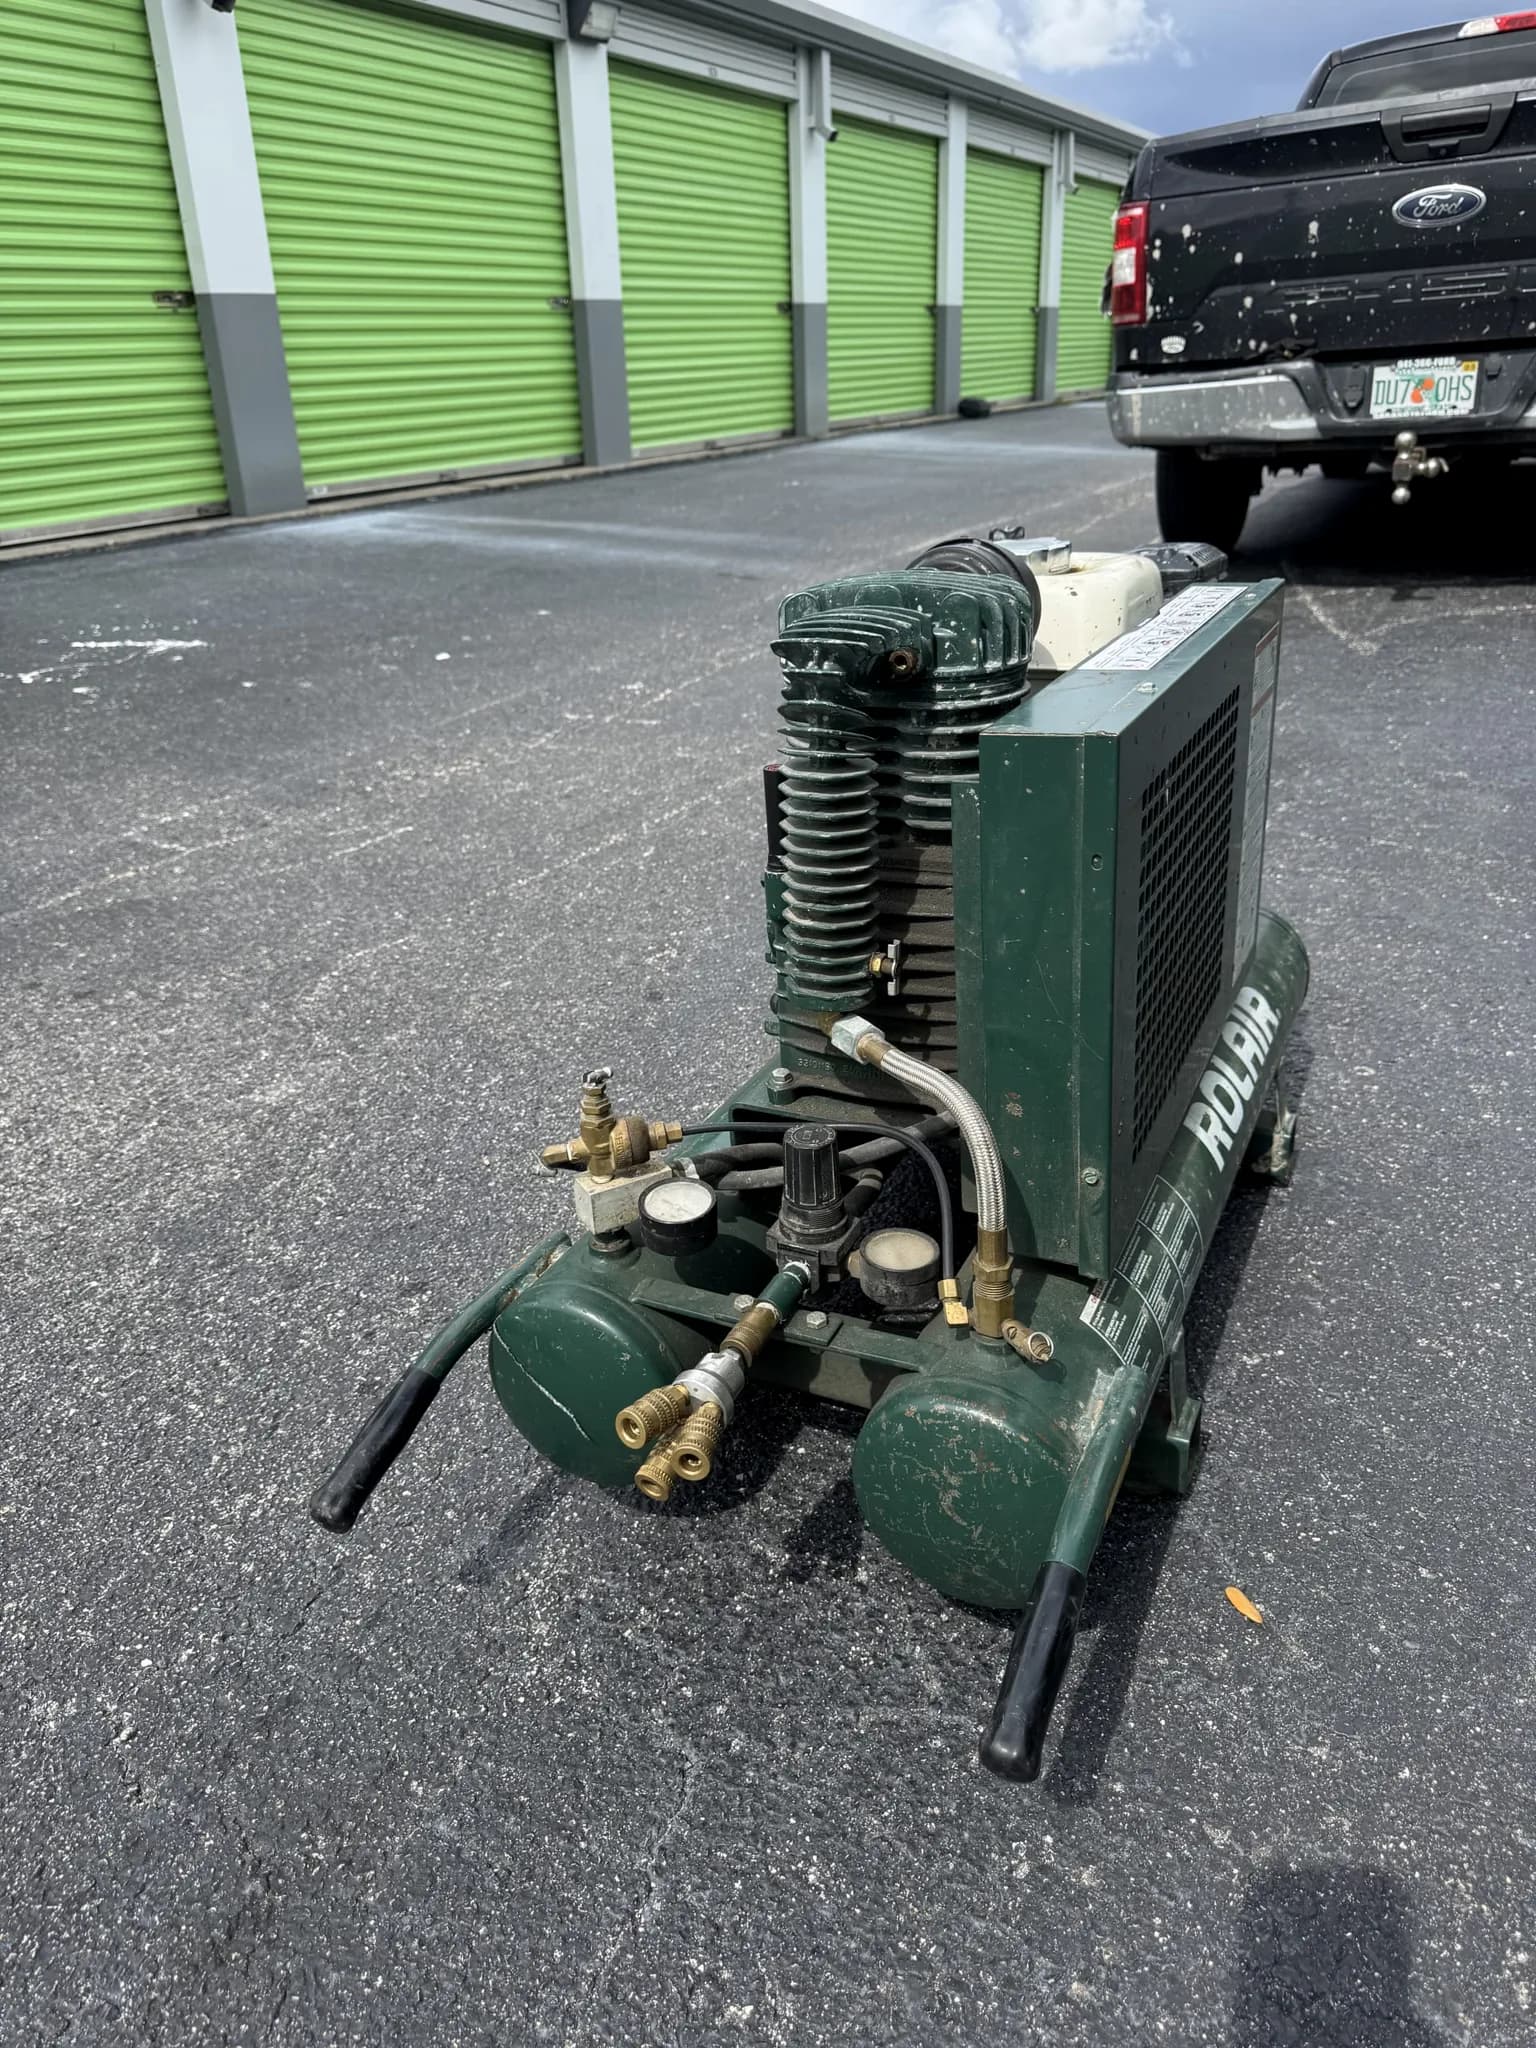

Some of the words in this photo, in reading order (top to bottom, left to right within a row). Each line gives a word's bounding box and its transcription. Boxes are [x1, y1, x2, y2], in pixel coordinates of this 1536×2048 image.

[1413, 193, 1465, 218] Ford
[1374, 379, 1412, 405] DU7
[1183, 986, 1280, 1173] ROLAIR
